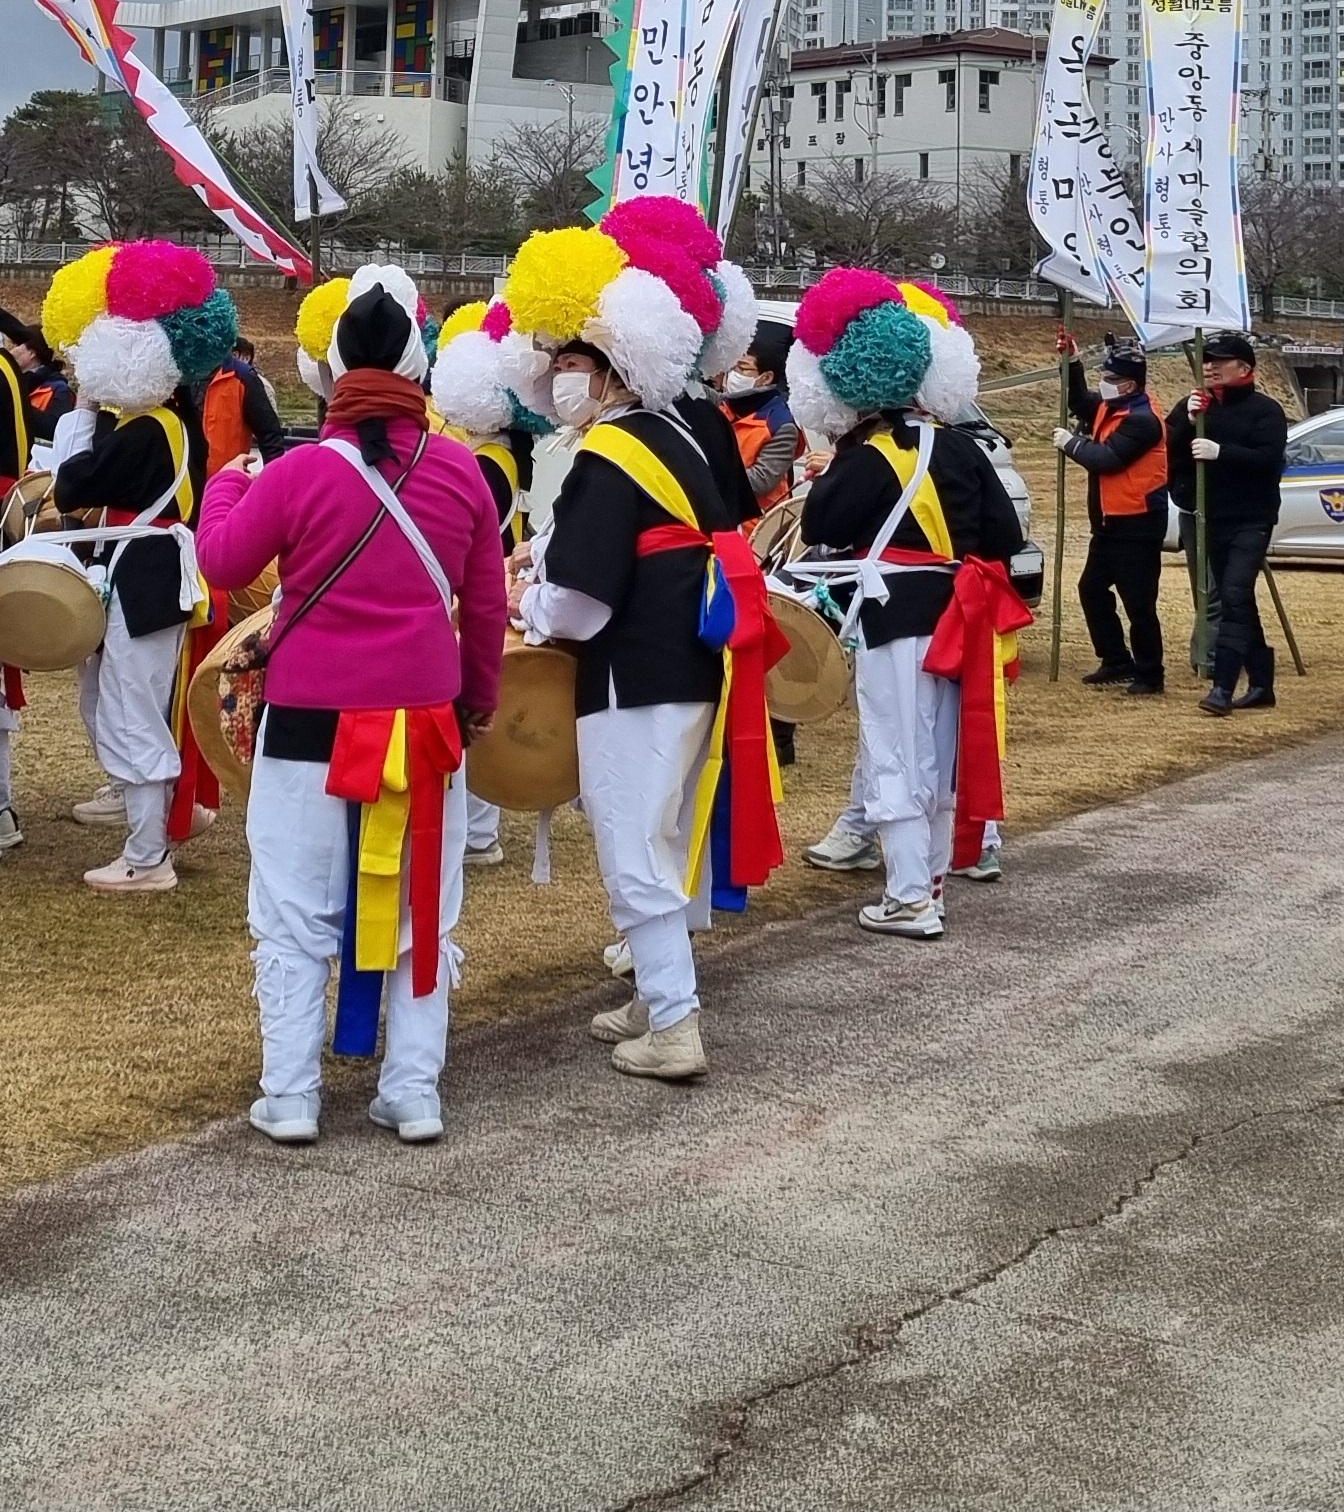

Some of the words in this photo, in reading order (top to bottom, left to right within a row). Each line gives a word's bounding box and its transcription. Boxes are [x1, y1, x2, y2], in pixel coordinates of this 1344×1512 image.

[1174, 32, 1211, 123] 중앙동
[1035, 88, 1055, 217] 만사형통
[1154, 105, 1176, 240] 만사형통
[1174, 136, 1212, 316] 새마을협의회
